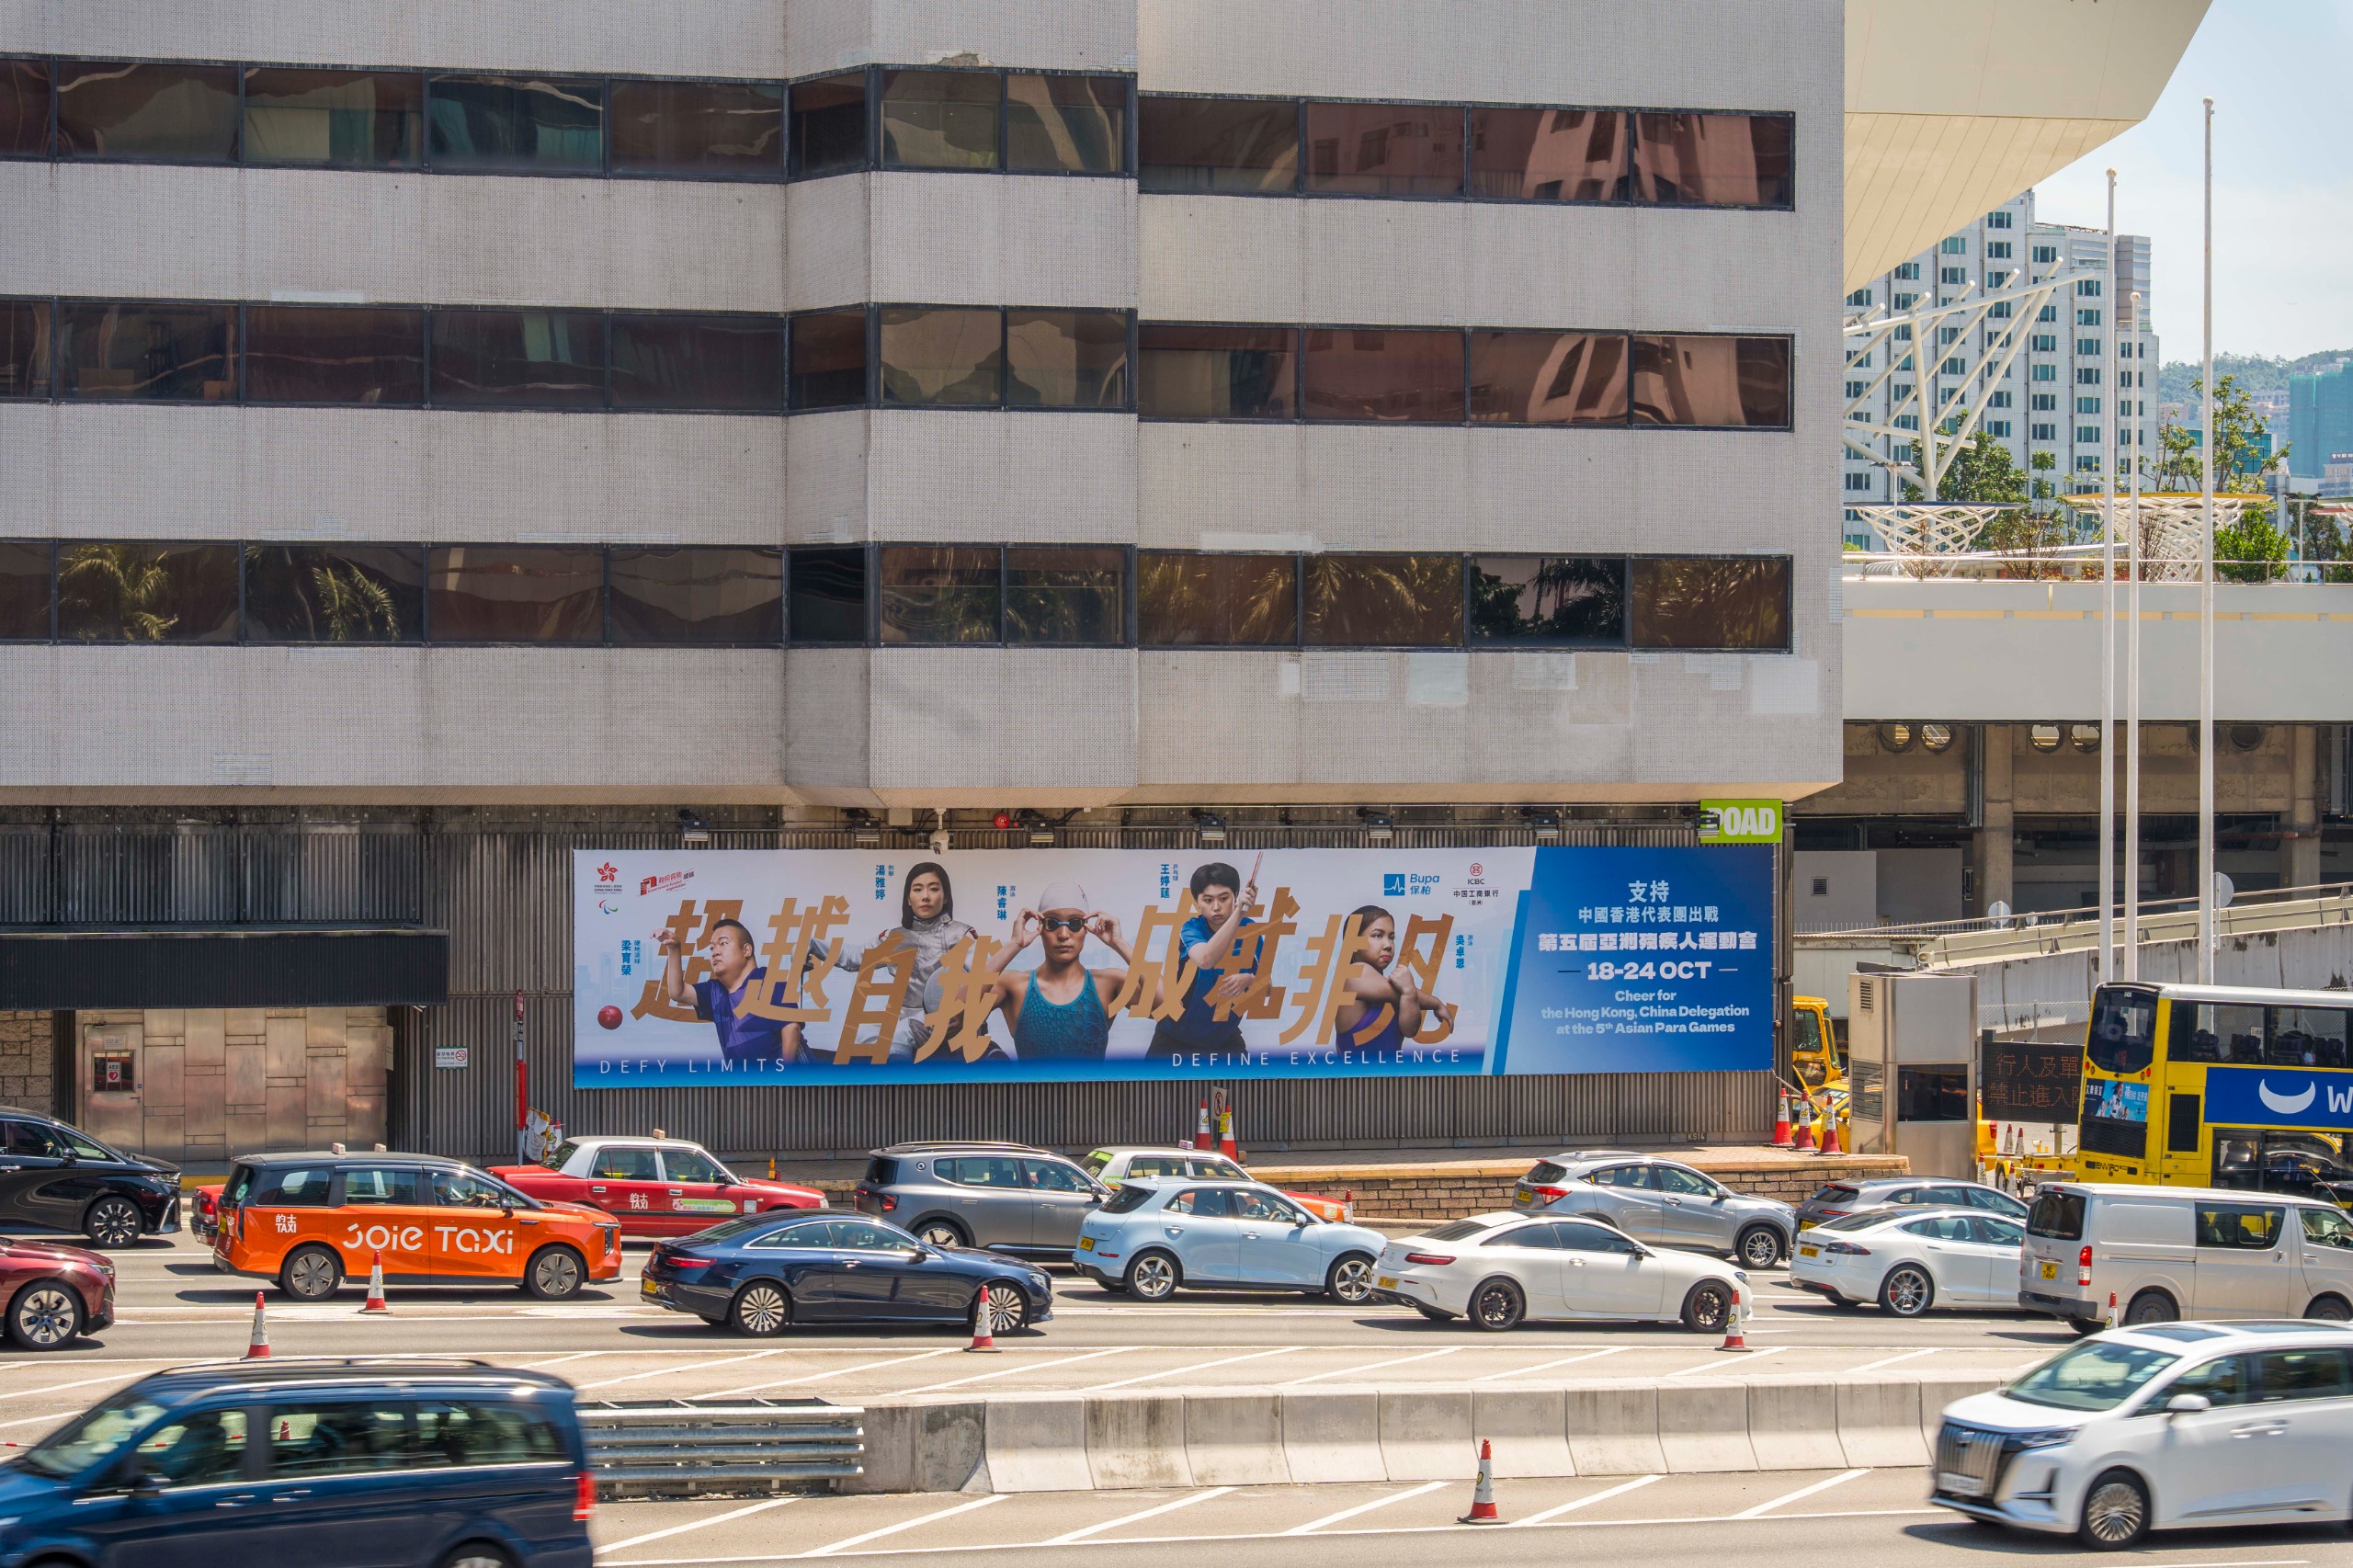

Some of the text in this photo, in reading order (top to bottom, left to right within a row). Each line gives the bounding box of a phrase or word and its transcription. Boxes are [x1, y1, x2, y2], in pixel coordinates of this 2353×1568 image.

[875, 865, 885, 900] 湯雅婷
[1410, 873, 1440, 885] Bupa
[1410, 885, 1431, 895] 保柏
[1628, 880, 1670, 903] 支持
[996, 885, 1007, 921] 陳睿琳
[1578, 905, 1720, 924] 中國香港代表團出戰
[1538, 930, 1758, 952] 第五屆亞洲殘疾人運動會
[621, 939, 631, 976] 梁育榮
[1455, 934, 1465, 970] 吳卓恩
[631, 887, 1460, 1065] 超越自我 成就非凡
[1587, 960, 1712, 981] 18-24 OCT
[1614, 988, 1677, 1002] Cheer for
[1540, 1004, 1750, 1023] the Hong Kong, China Delegation
[1555, 1022, 1735, 1035] at the 5th Asian Para Games
[600, 1058, 785, 1074] DEFY LIMITS
[1172, 1049, 1460, 1067] DEFINE EXCELLENCE
[1688, 1132, 1705, 1141] KS14
[630, 1193, 648, 1201] 的士
[631, 1200, 649, 1210] TAXI
[275, 1213, 297, 1223] 的士
[275, 1222, 297, 1233] TAXI
